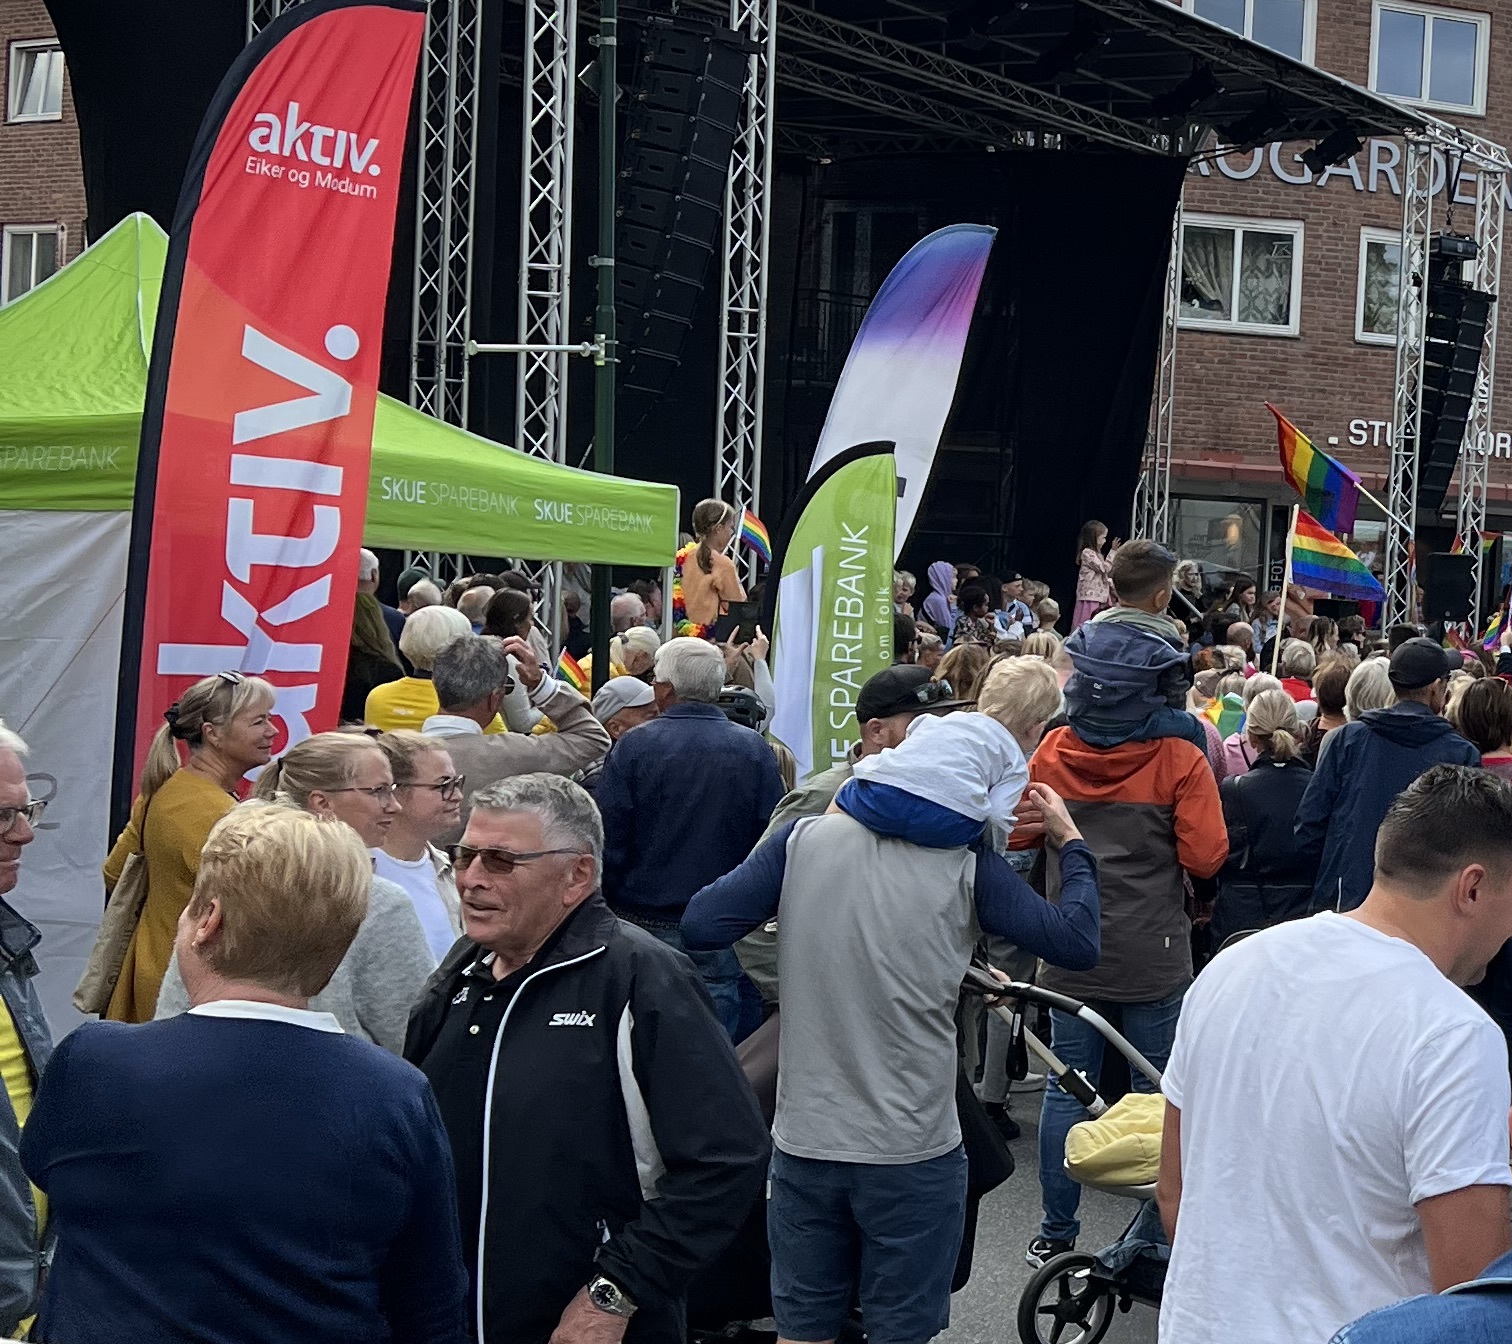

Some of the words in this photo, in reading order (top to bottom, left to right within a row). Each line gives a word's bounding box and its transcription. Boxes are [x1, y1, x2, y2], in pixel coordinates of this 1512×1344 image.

[245, 156, 286, 179] Eiker
[288, 168, 311, 189] og
[314, 170, 377, 200] Modum
[381, 476, 427, 505] SKUE
[429, 482, 519, 517] SPAREBANK
[533, 498, 573, 525] SKUE
[575, 505, 654, 535] SPAREBANK
[829, 521, 869, 730] SPAREBANK
[875, 586, 890, 625] folk
[879, 635, 890, 660] om
